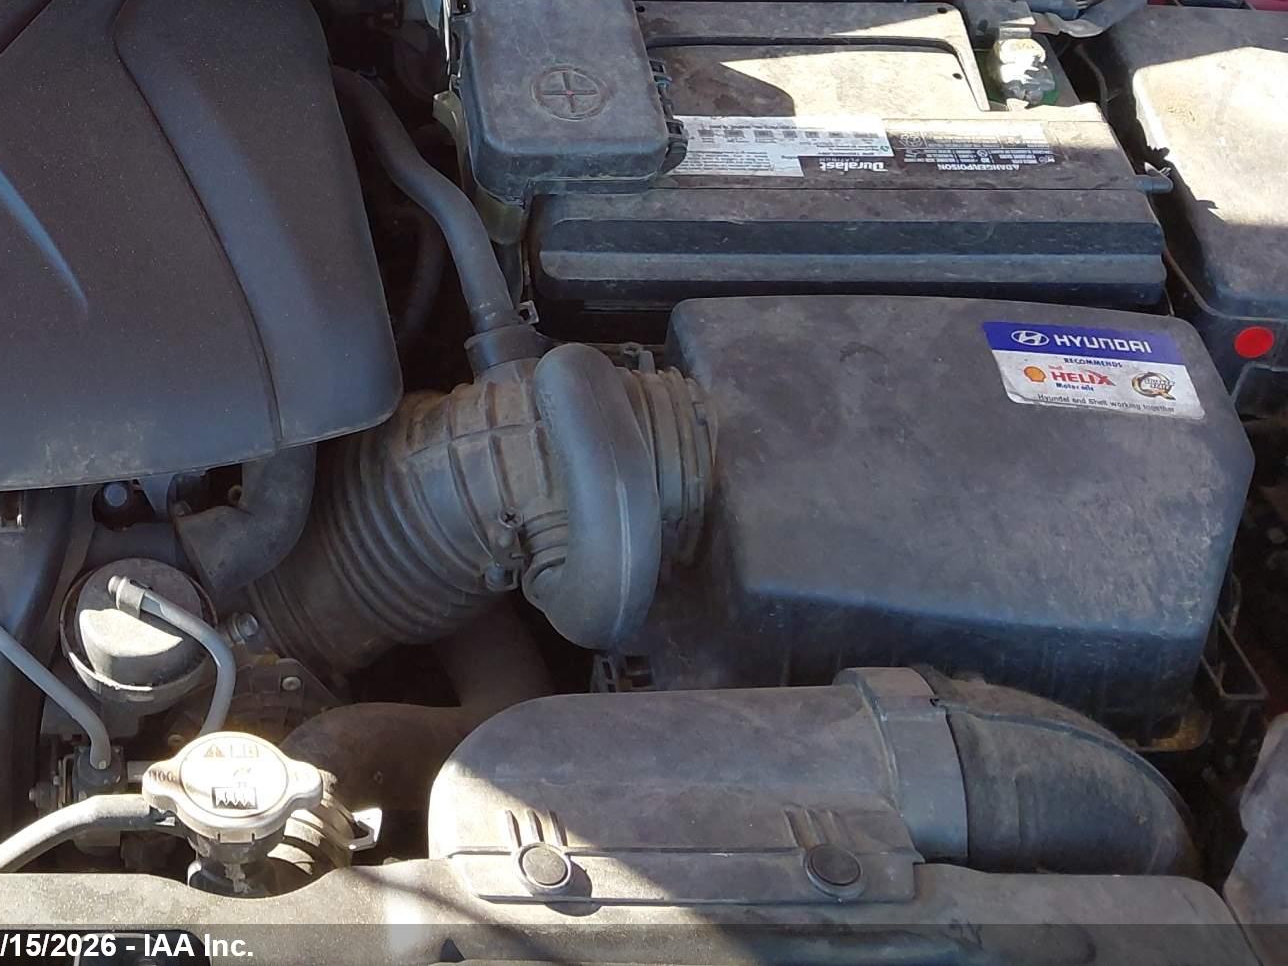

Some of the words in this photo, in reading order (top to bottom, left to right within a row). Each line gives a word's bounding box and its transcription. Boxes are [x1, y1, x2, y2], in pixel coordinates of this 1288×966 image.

[818, 161, 889, 172] Duralast
[1053, 334, 1152, 353] HYUNDAI
[1063, 357, 1123, 368] RECOMMENDS
[1051, 369, 1117, 387] HELIX
[1037, 393, 1070, 404] Hyundai
[1072, 395, 1087, 404] and
[1088, 398, 1108, 406] Shell
[1110, 400, 1142, 411] working
[1143, 404, 1175, 413] together
